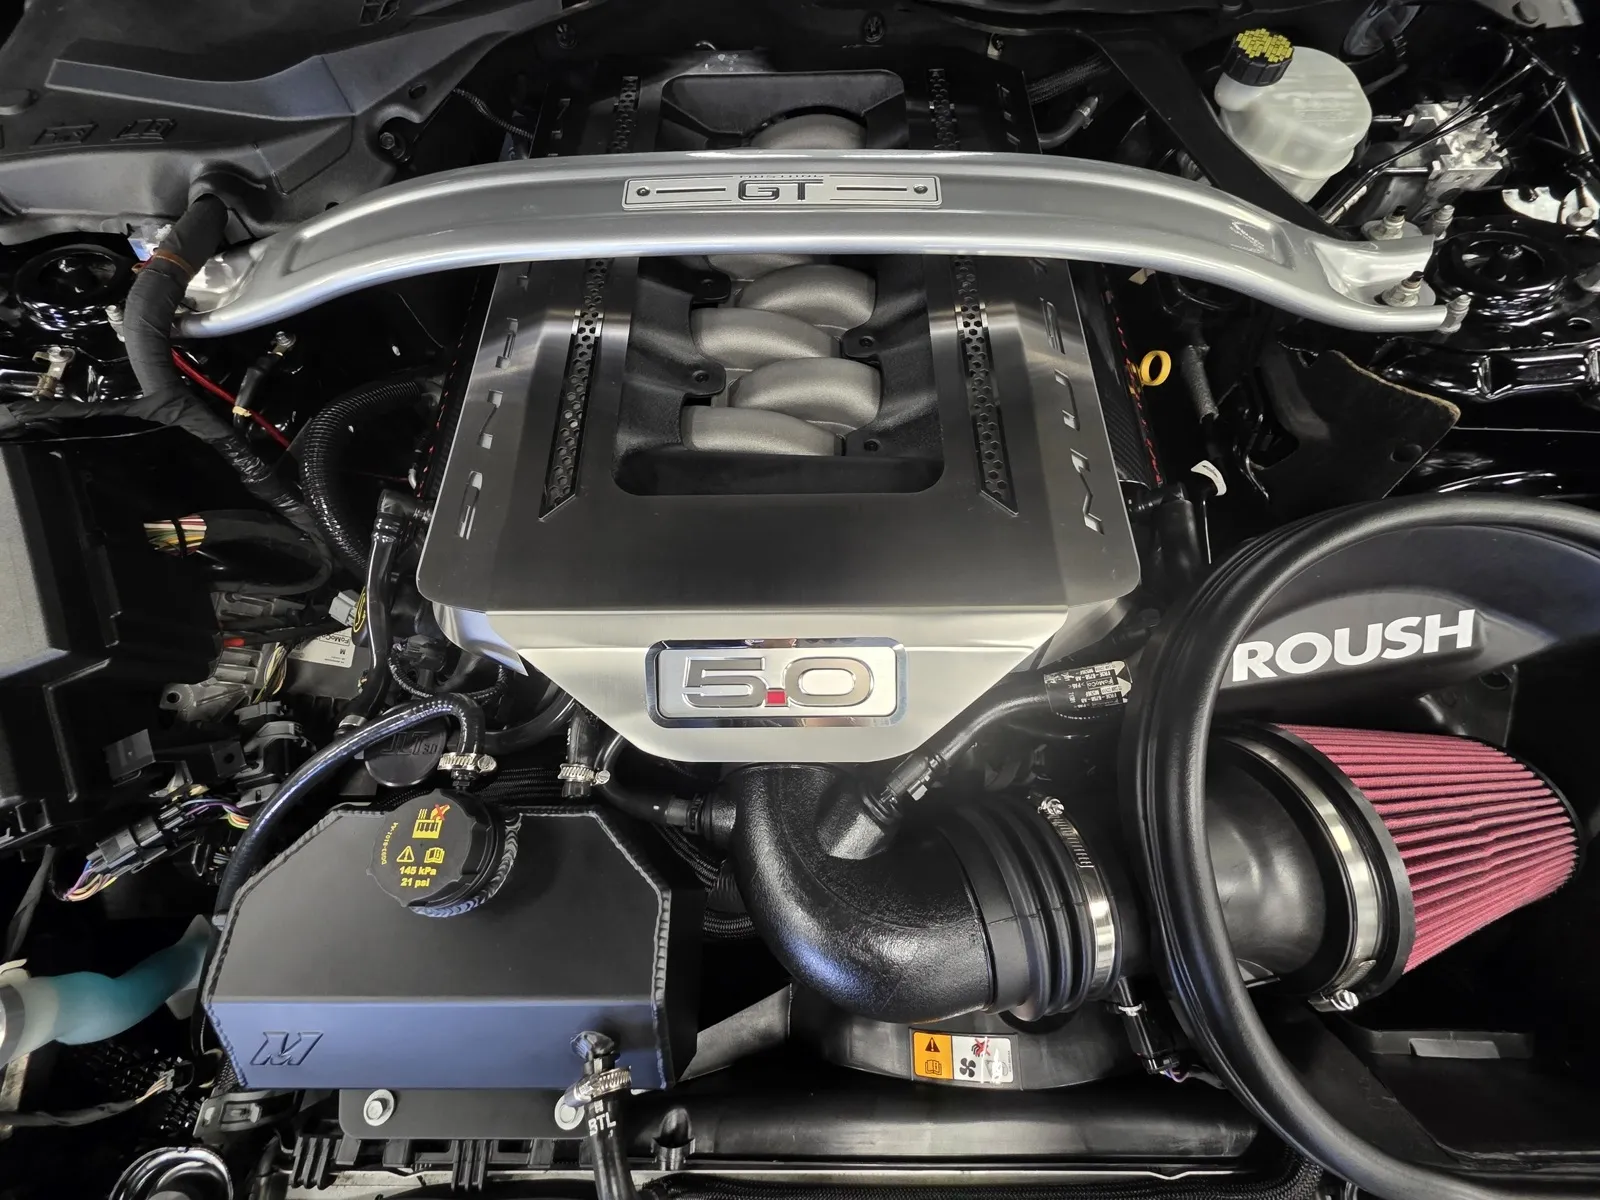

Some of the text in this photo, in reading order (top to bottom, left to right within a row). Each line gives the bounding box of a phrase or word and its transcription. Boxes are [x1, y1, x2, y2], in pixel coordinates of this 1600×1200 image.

[737, 179, 824, 202] GT
[1232, 609, 1476, 682] ROUSH
[682, 656, 875, 709] 5.0
[399, 865, 437, 876] 145 kPa
[400, 877, 431, 889] 21 psi
